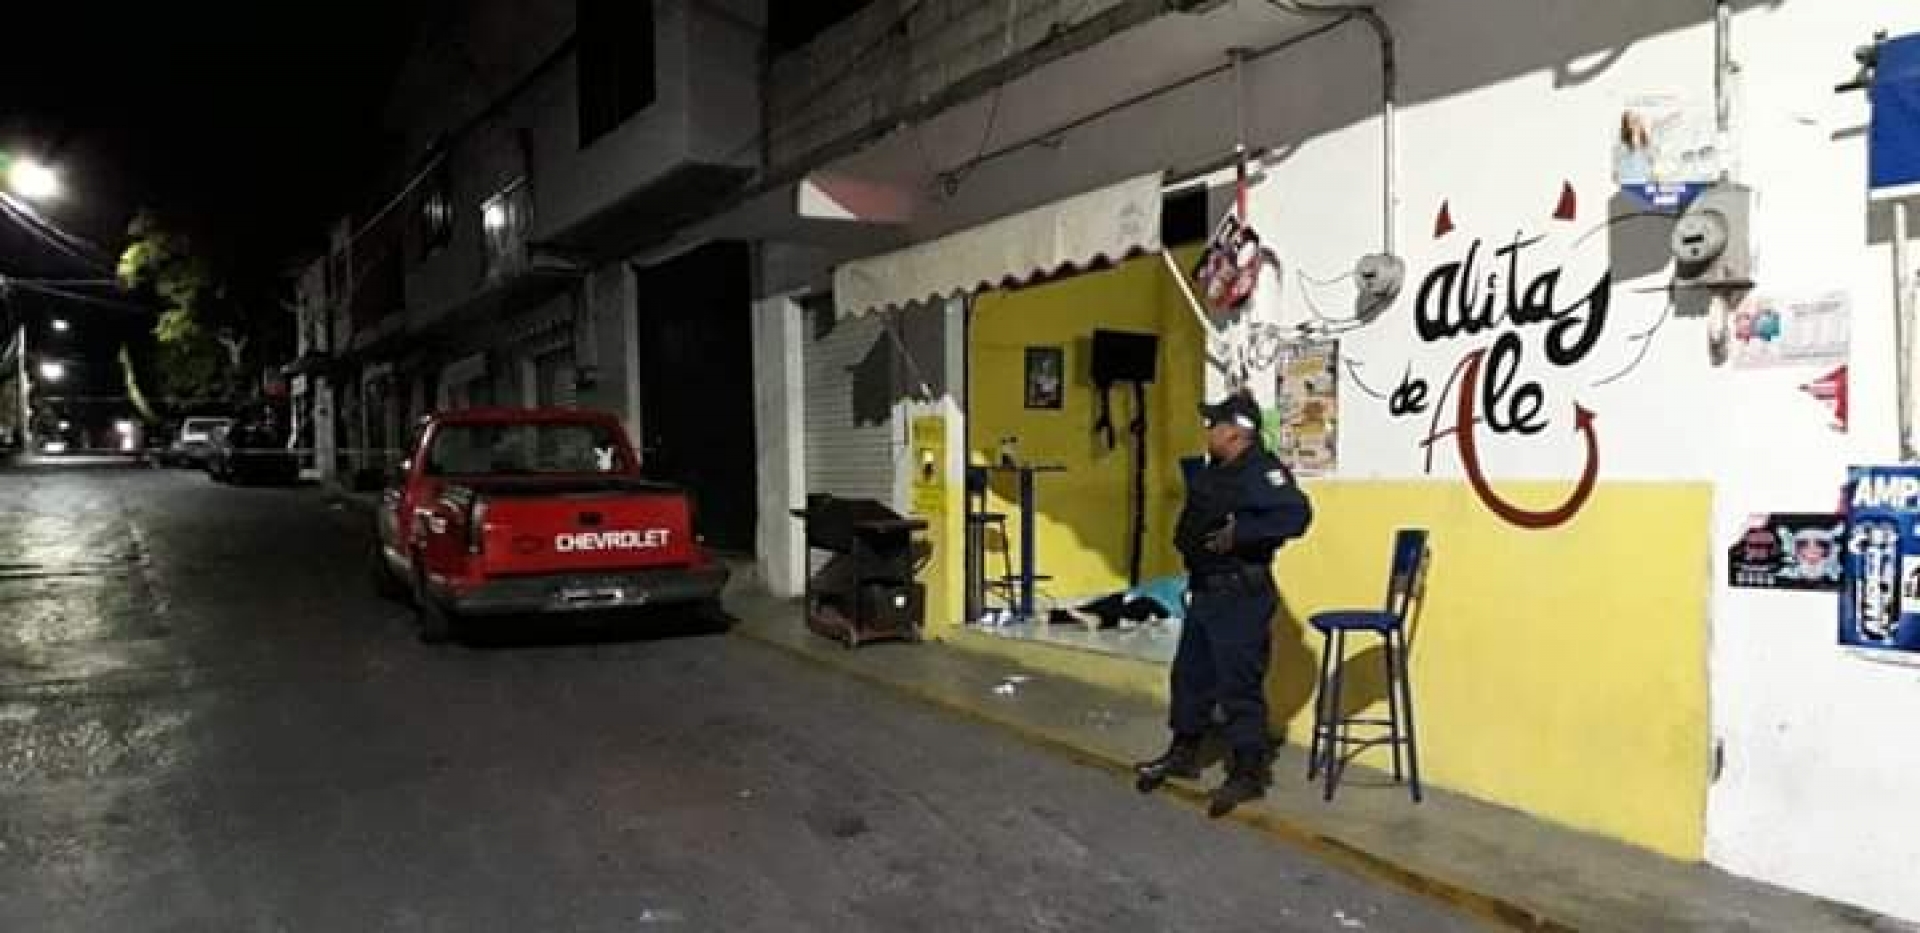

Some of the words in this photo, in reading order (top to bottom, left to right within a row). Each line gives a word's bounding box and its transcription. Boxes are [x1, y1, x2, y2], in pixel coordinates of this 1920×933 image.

[1389, 361, 1428, 415] de
[1419, 331, 1552, 480] Ale
[555, 528, 670, 552] CHEVROLET
